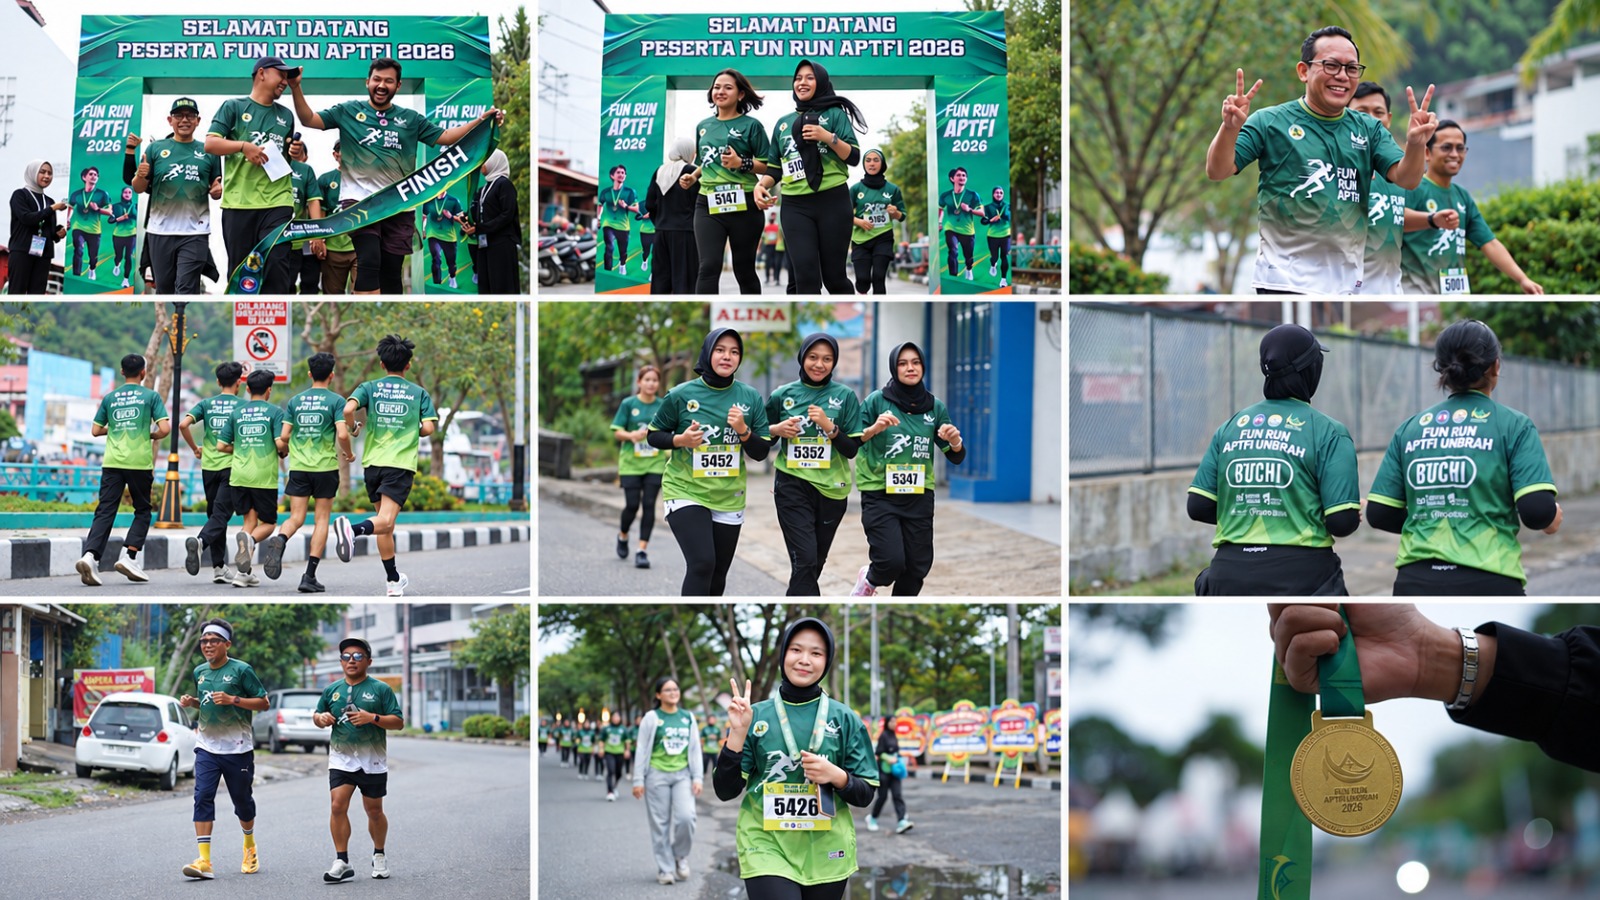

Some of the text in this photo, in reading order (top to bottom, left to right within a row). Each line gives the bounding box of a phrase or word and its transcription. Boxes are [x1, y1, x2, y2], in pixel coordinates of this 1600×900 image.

[182, 19, 388, 36] SELAMAT DATANG
[708, 16, 896, 34] SELAMAT DATANG
[117, 42, 454, 60] PESERTA FUN RUN APTFI 2026
[641, 40, 964, 56] PESERTA FUN RUN APTFI 2026
[82, 104, 134, 118] FUN RUN
[435, 105, 486, 118] FUN RUN
[608, 102, 657, 116] FUN RUN
[945, 104, 999, 117] FUN RUN
[80, 120, 128, 138] APTFI
[607, 118, 653, 136] APTFI
[944, 119, 995, 138] APTFI
[87, 140, 122, 152] 2026
[614, 138, 646, 150] 2026
[952, 140, 988, 152] 2026
[396, 145, 469, 202] FINISH
[788, 160, 804, 174] 510
[1337, 167, 1357, 179] FUN
[1338, 179, 1357, 190] RUN
[715, 192, 736, 205] 5147
[1445, 278, 1464, 291] 5001
[717, 308, 786, 321] ALINA
[1240, 429, 1292, 442] FUN RUN
[1422, 426, 1477, 438] FUN RUN
[794, 446, 825, 459] 5352
[1222, 440, 1306, 458] APTFI UNBRAH
[1405, 438, 1493, 453] APTFI UNBRAH
[701, 454, 733, 468] 5452
[892, 473, 918, 485] 5347
[1235, 462, 1282, 484] BUCHI
[1416, 461, 1466, 484] BUCHI
[774, 798, 818, 816] 5426
